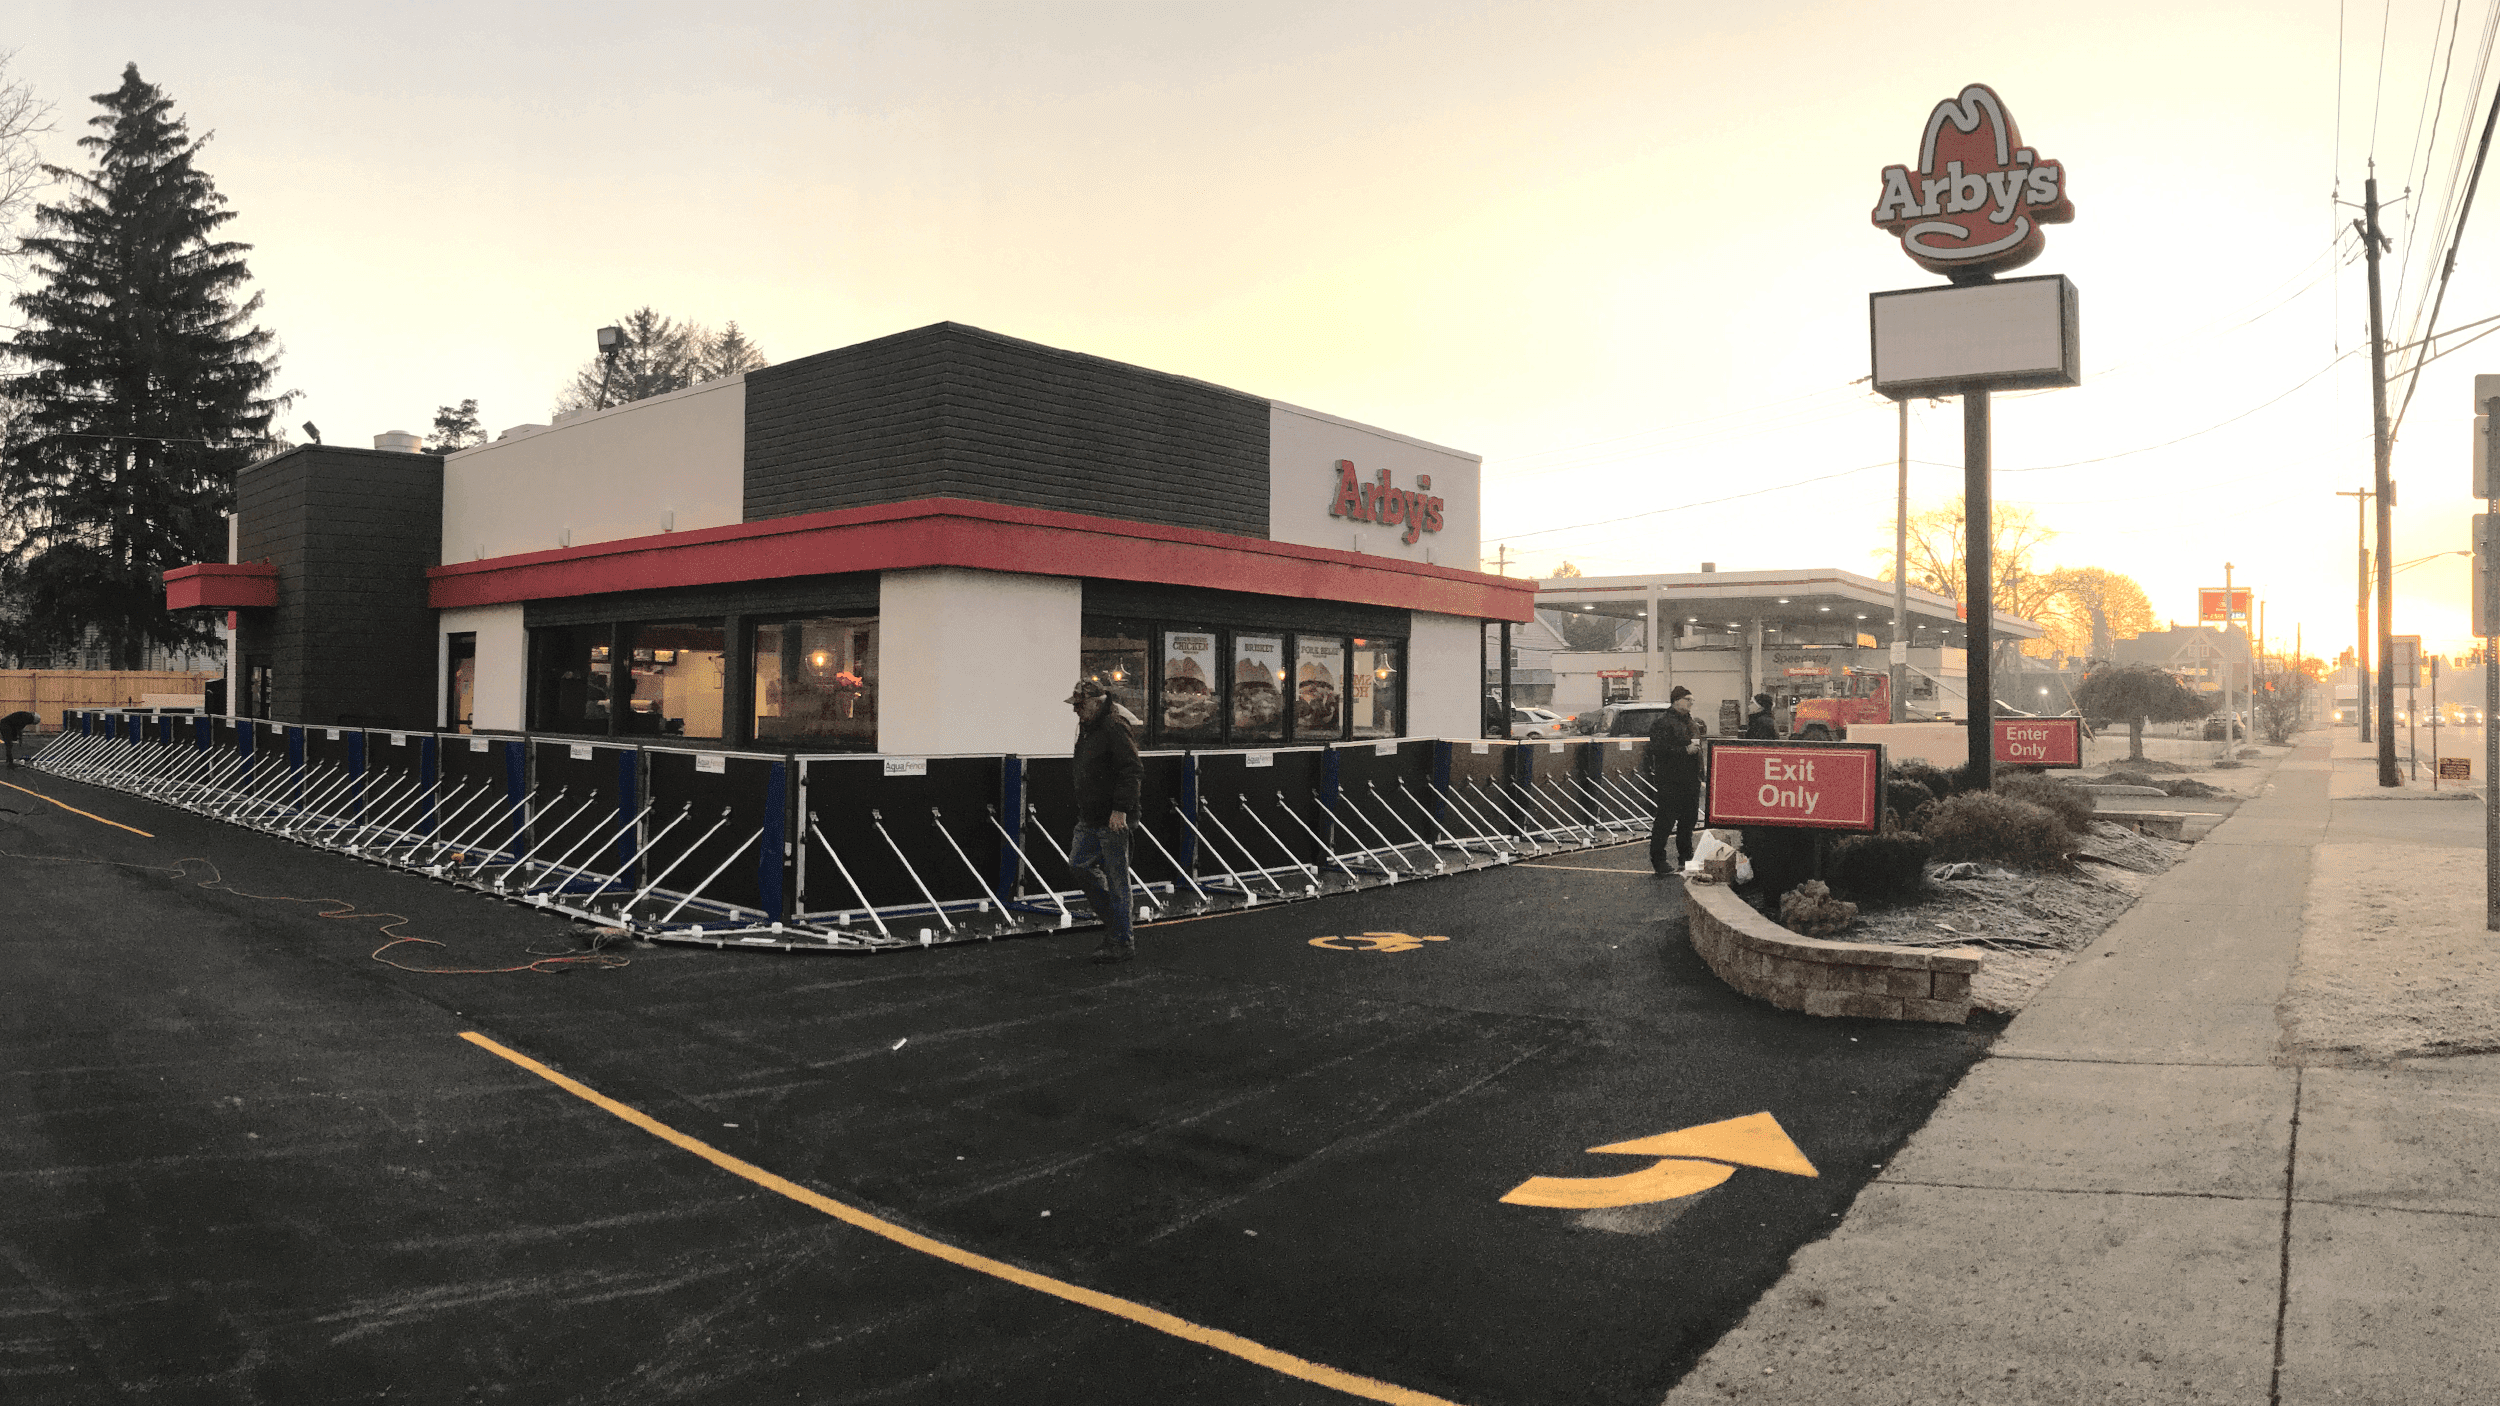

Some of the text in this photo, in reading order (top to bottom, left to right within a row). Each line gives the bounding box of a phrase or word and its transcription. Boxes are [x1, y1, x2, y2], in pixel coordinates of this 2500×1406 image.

[1875, 149, 2059, 224] Arby's
[1329, 459, 1444, 545] Arby's
[1172, 641, 1208, 651] CHICKEN
[1772, 652, 1832, 665] Speedway
[2006, 726, 2049, 741] Enter
[2010, 742, 2046, 759] Only
[1764, 757, 1815, 781] Exit
[1758, 784, 1820, 815] Only
